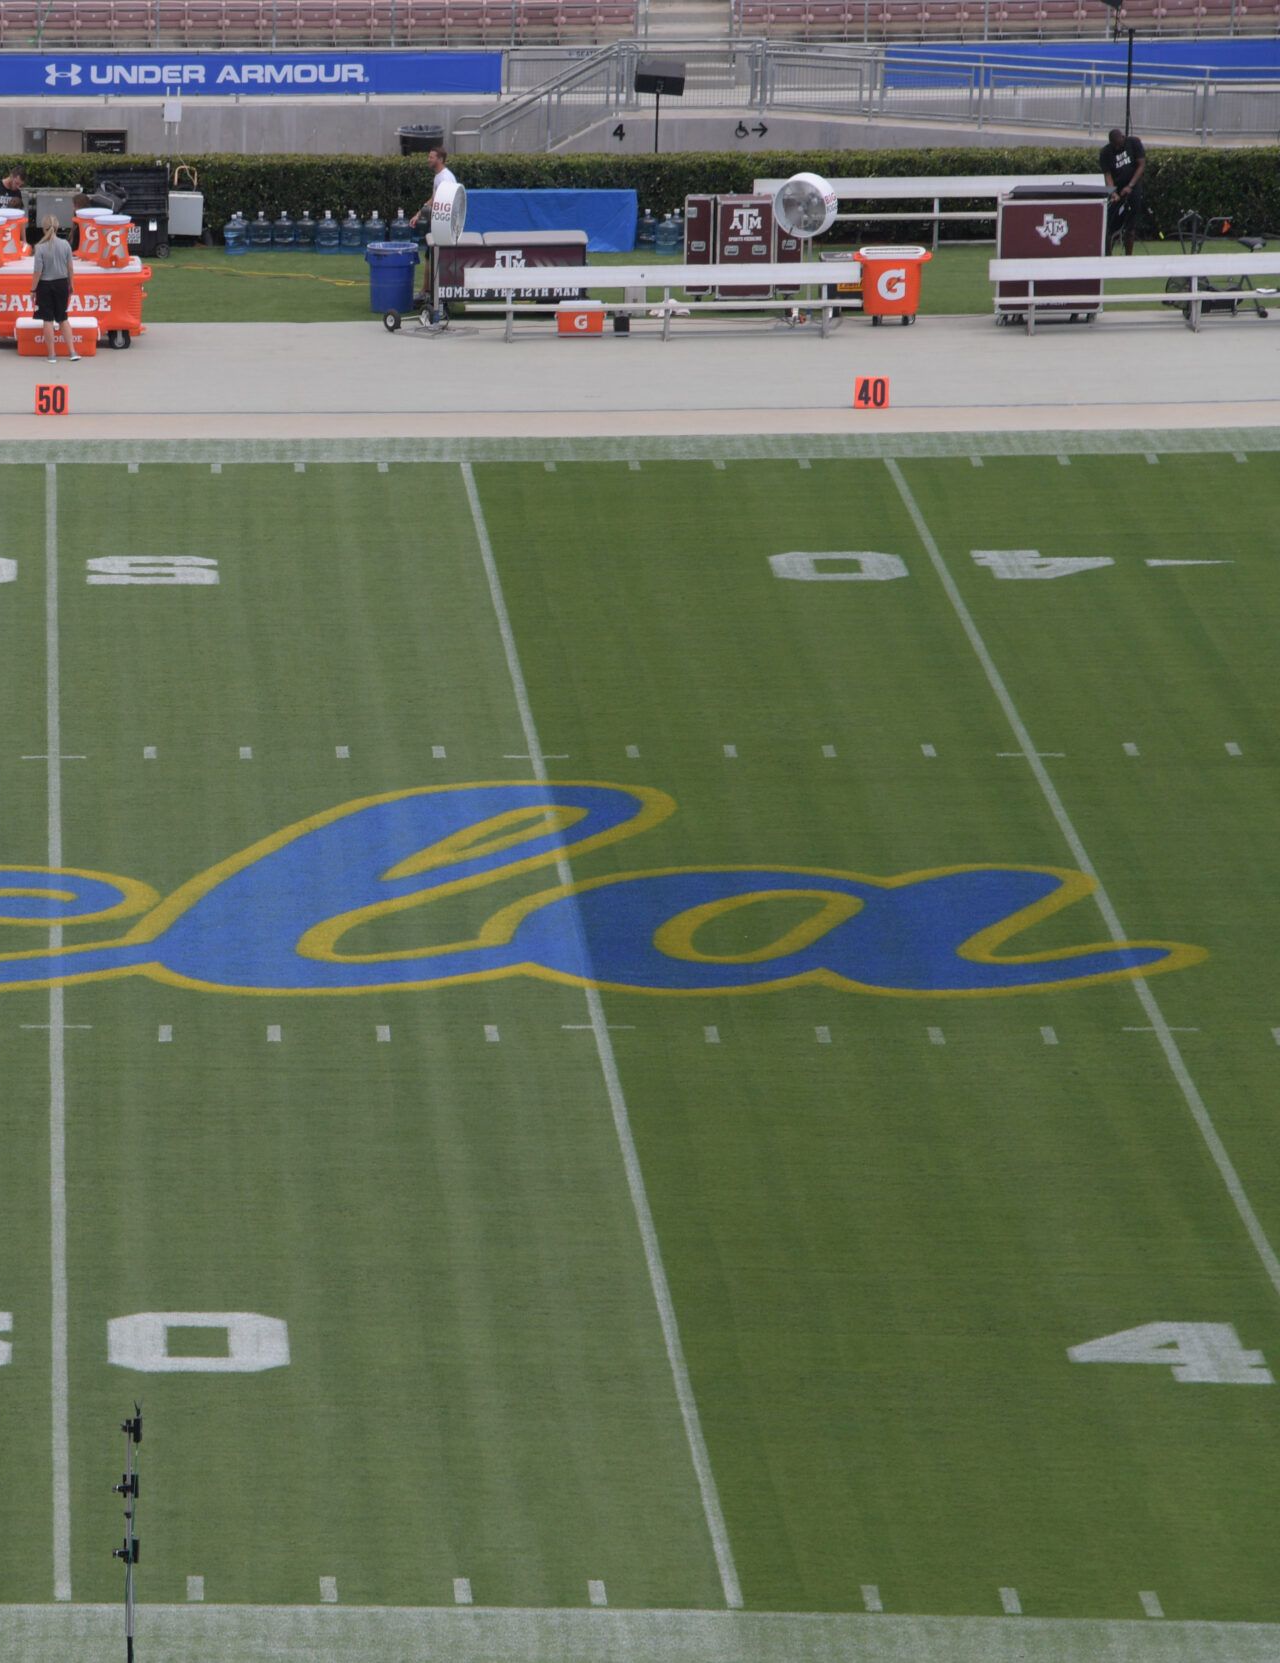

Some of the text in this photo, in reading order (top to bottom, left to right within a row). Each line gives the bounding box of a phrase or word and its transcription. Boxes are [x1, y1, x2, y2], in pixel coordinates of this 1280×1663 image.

[90, 63, 365, 84] UNDER ARMOUR
[612, 123, 626, 141] 4
[433, 202, 451, 212] BIG
[107, 230, 121, 247] G
[438, 286, 471, 299] HOME
[473, 287, 486, 298] OF
[519, 287, 549, 298] 12TH
[552, 287, 580, 297] MAN
[877, 268, 906, 300] G
[574, 314, 588, 329] G
[38, 386, 65, 413] 50
[857, 379, 886, 407] 40
[1066, 1321, 1277, 1384] 4
